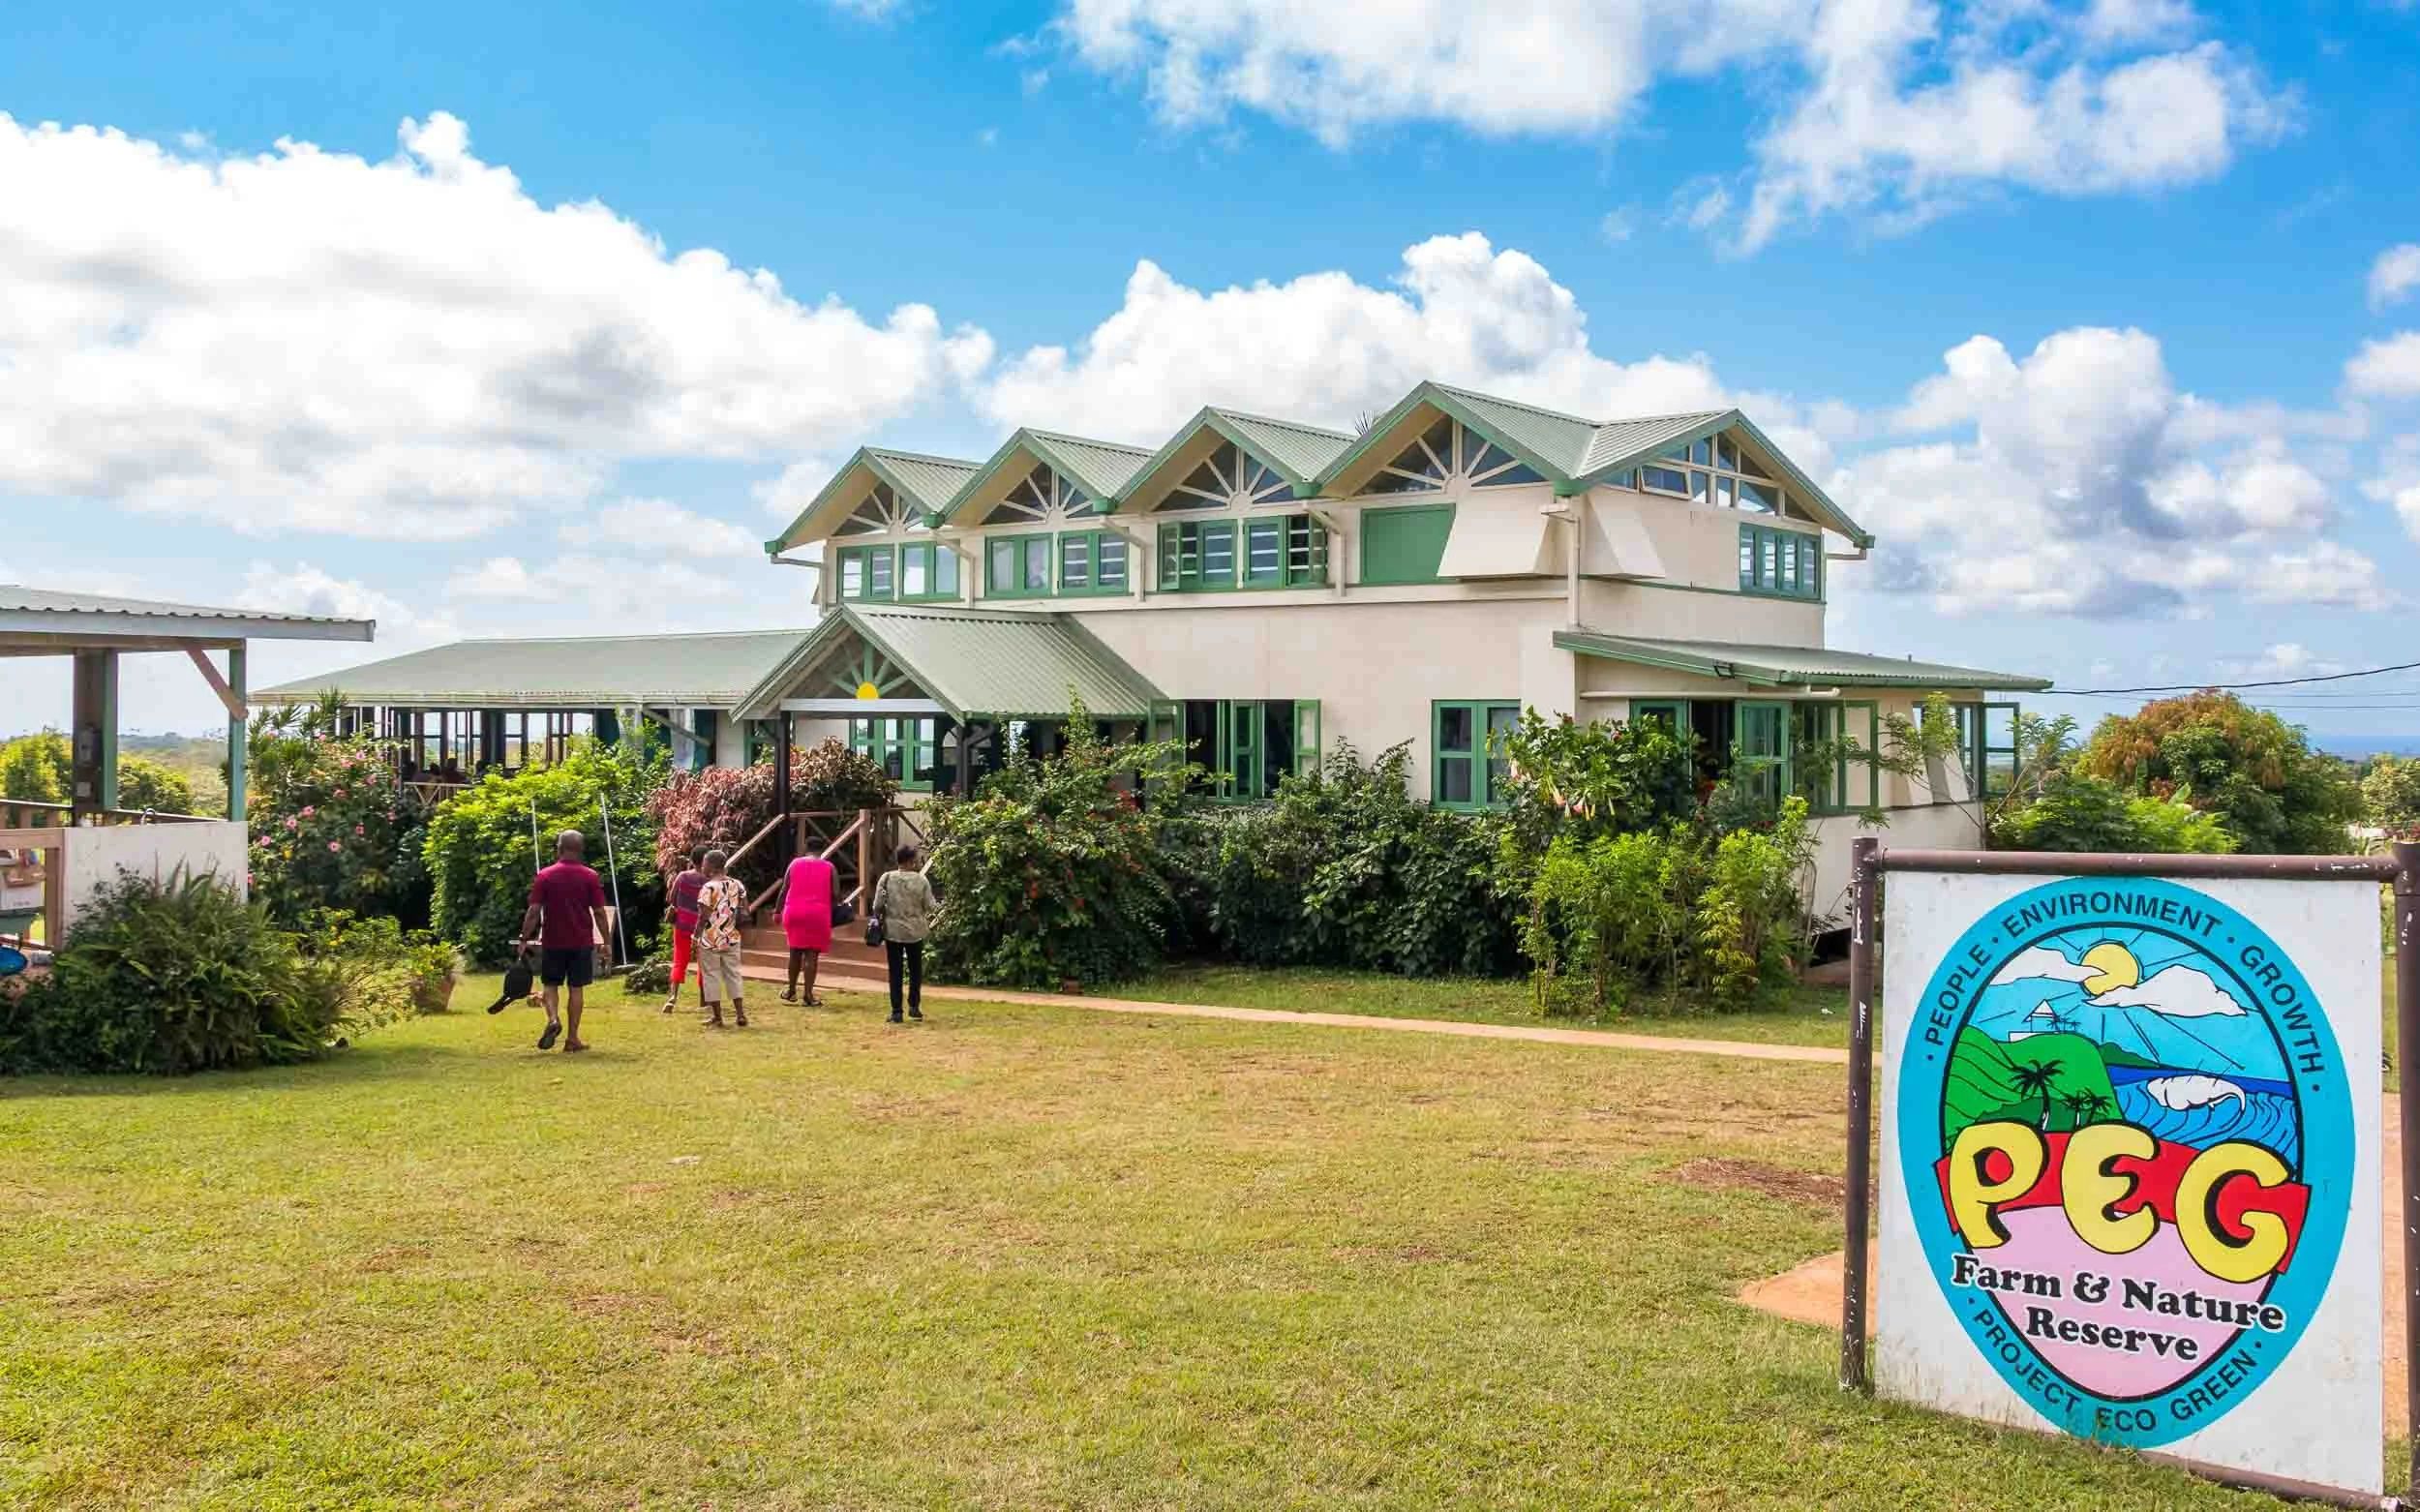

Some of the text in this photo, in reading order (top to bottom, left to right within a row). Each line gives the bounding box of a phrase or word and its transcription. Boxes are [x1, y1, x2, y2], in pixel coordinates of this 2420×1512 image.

[1924, 892, 2325, 1075] PEOPLE ENVIRONMENT GROWTH
[1949, 1120, 2299, 1283] PEG
[1951, 1255, 2284, 1331] Farm & Nature
[2027, 1307, 2197, 1360] Reserve
[1974, 1309, 2257, 1432] PROJECT ECO GREEN
